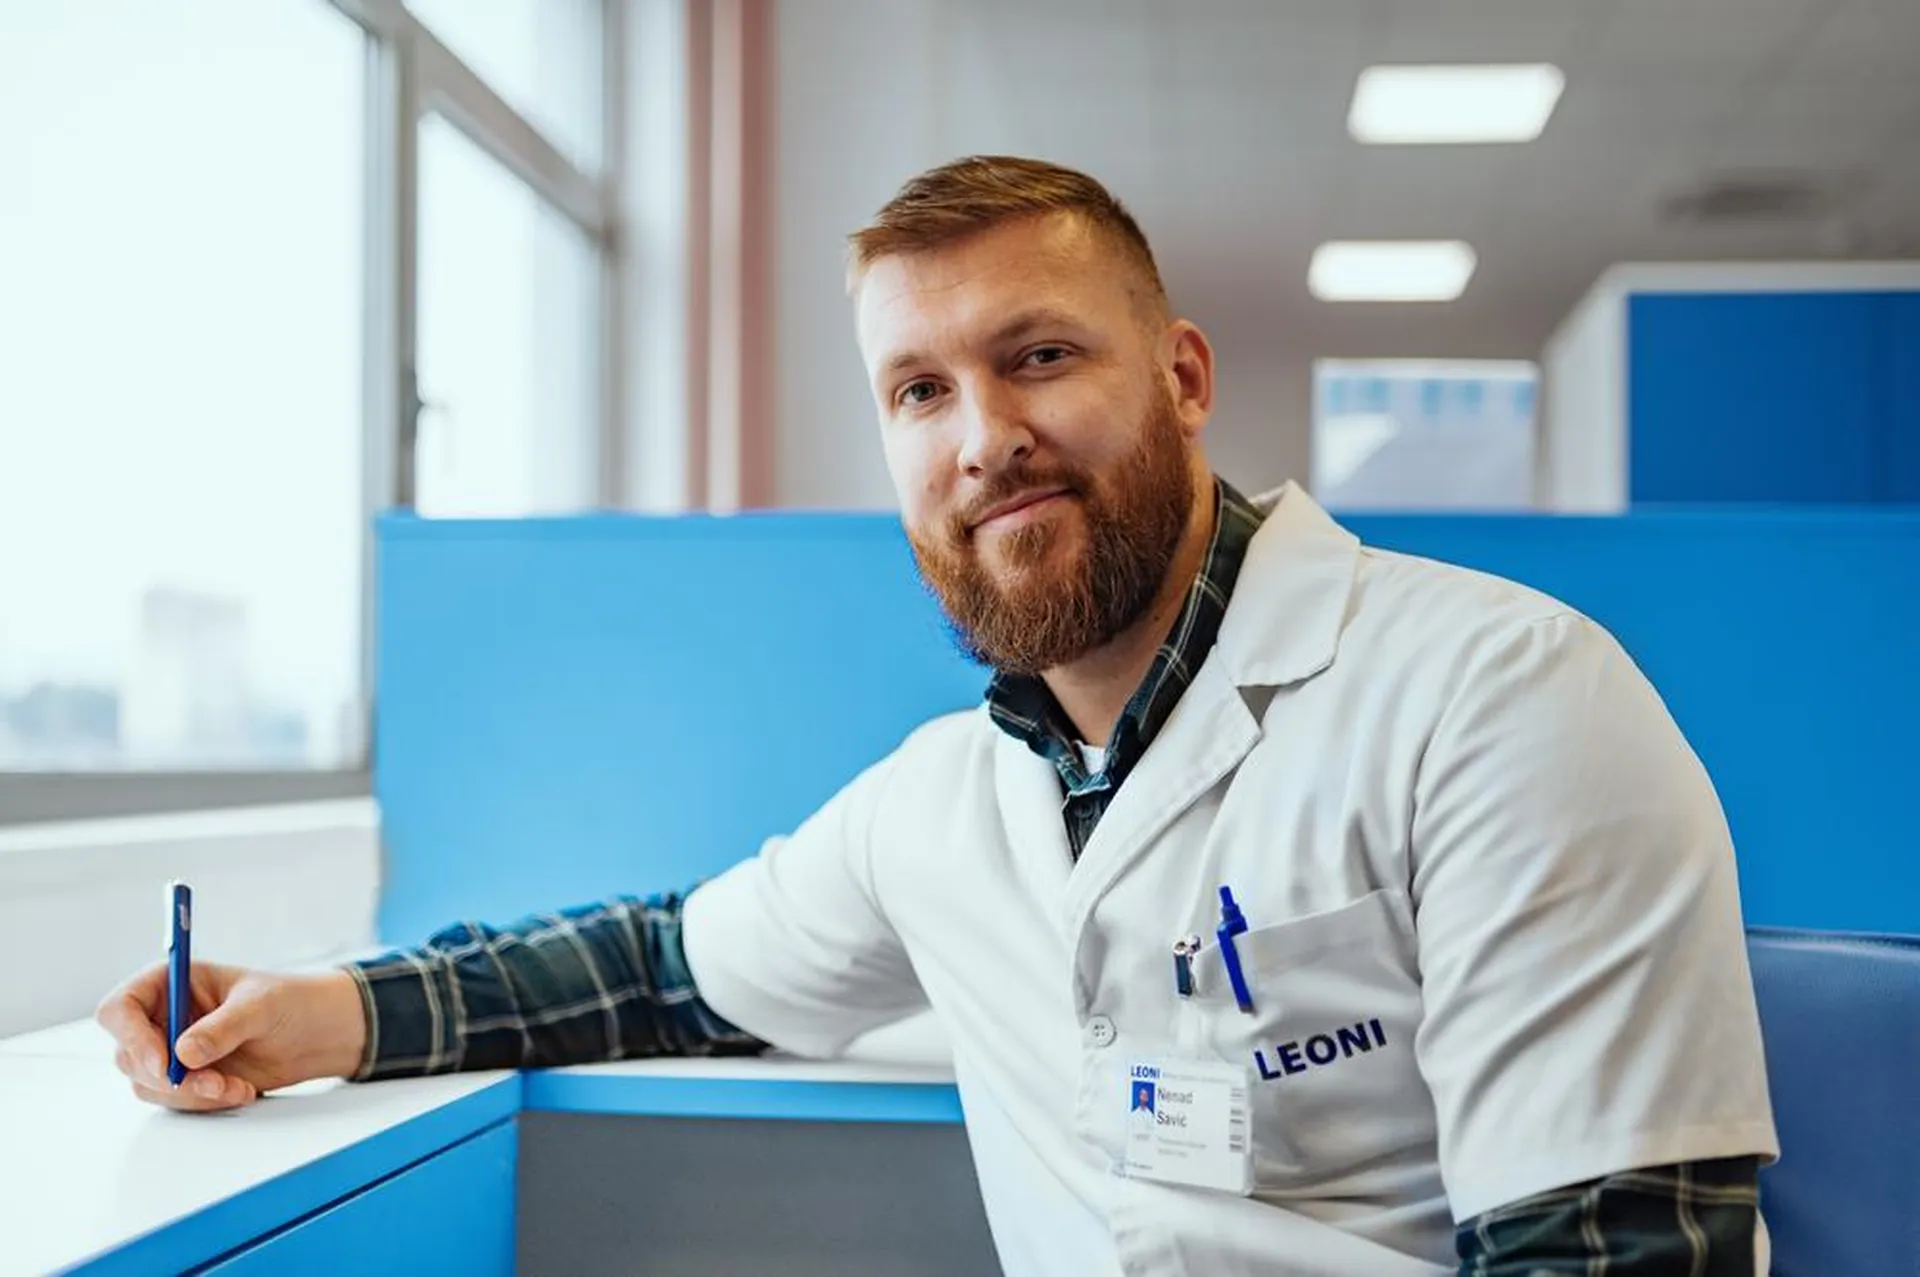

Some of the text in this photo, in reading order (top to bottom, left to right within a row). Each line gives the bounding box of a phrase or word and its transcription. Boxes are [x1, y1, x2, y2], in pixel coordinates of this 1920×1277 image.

[1254, 1018, 1387, 1081] LEONI
[1130, 1064, 1160, 1079] LEONI
[1157, 1086, 1193, 1104] Nenad
